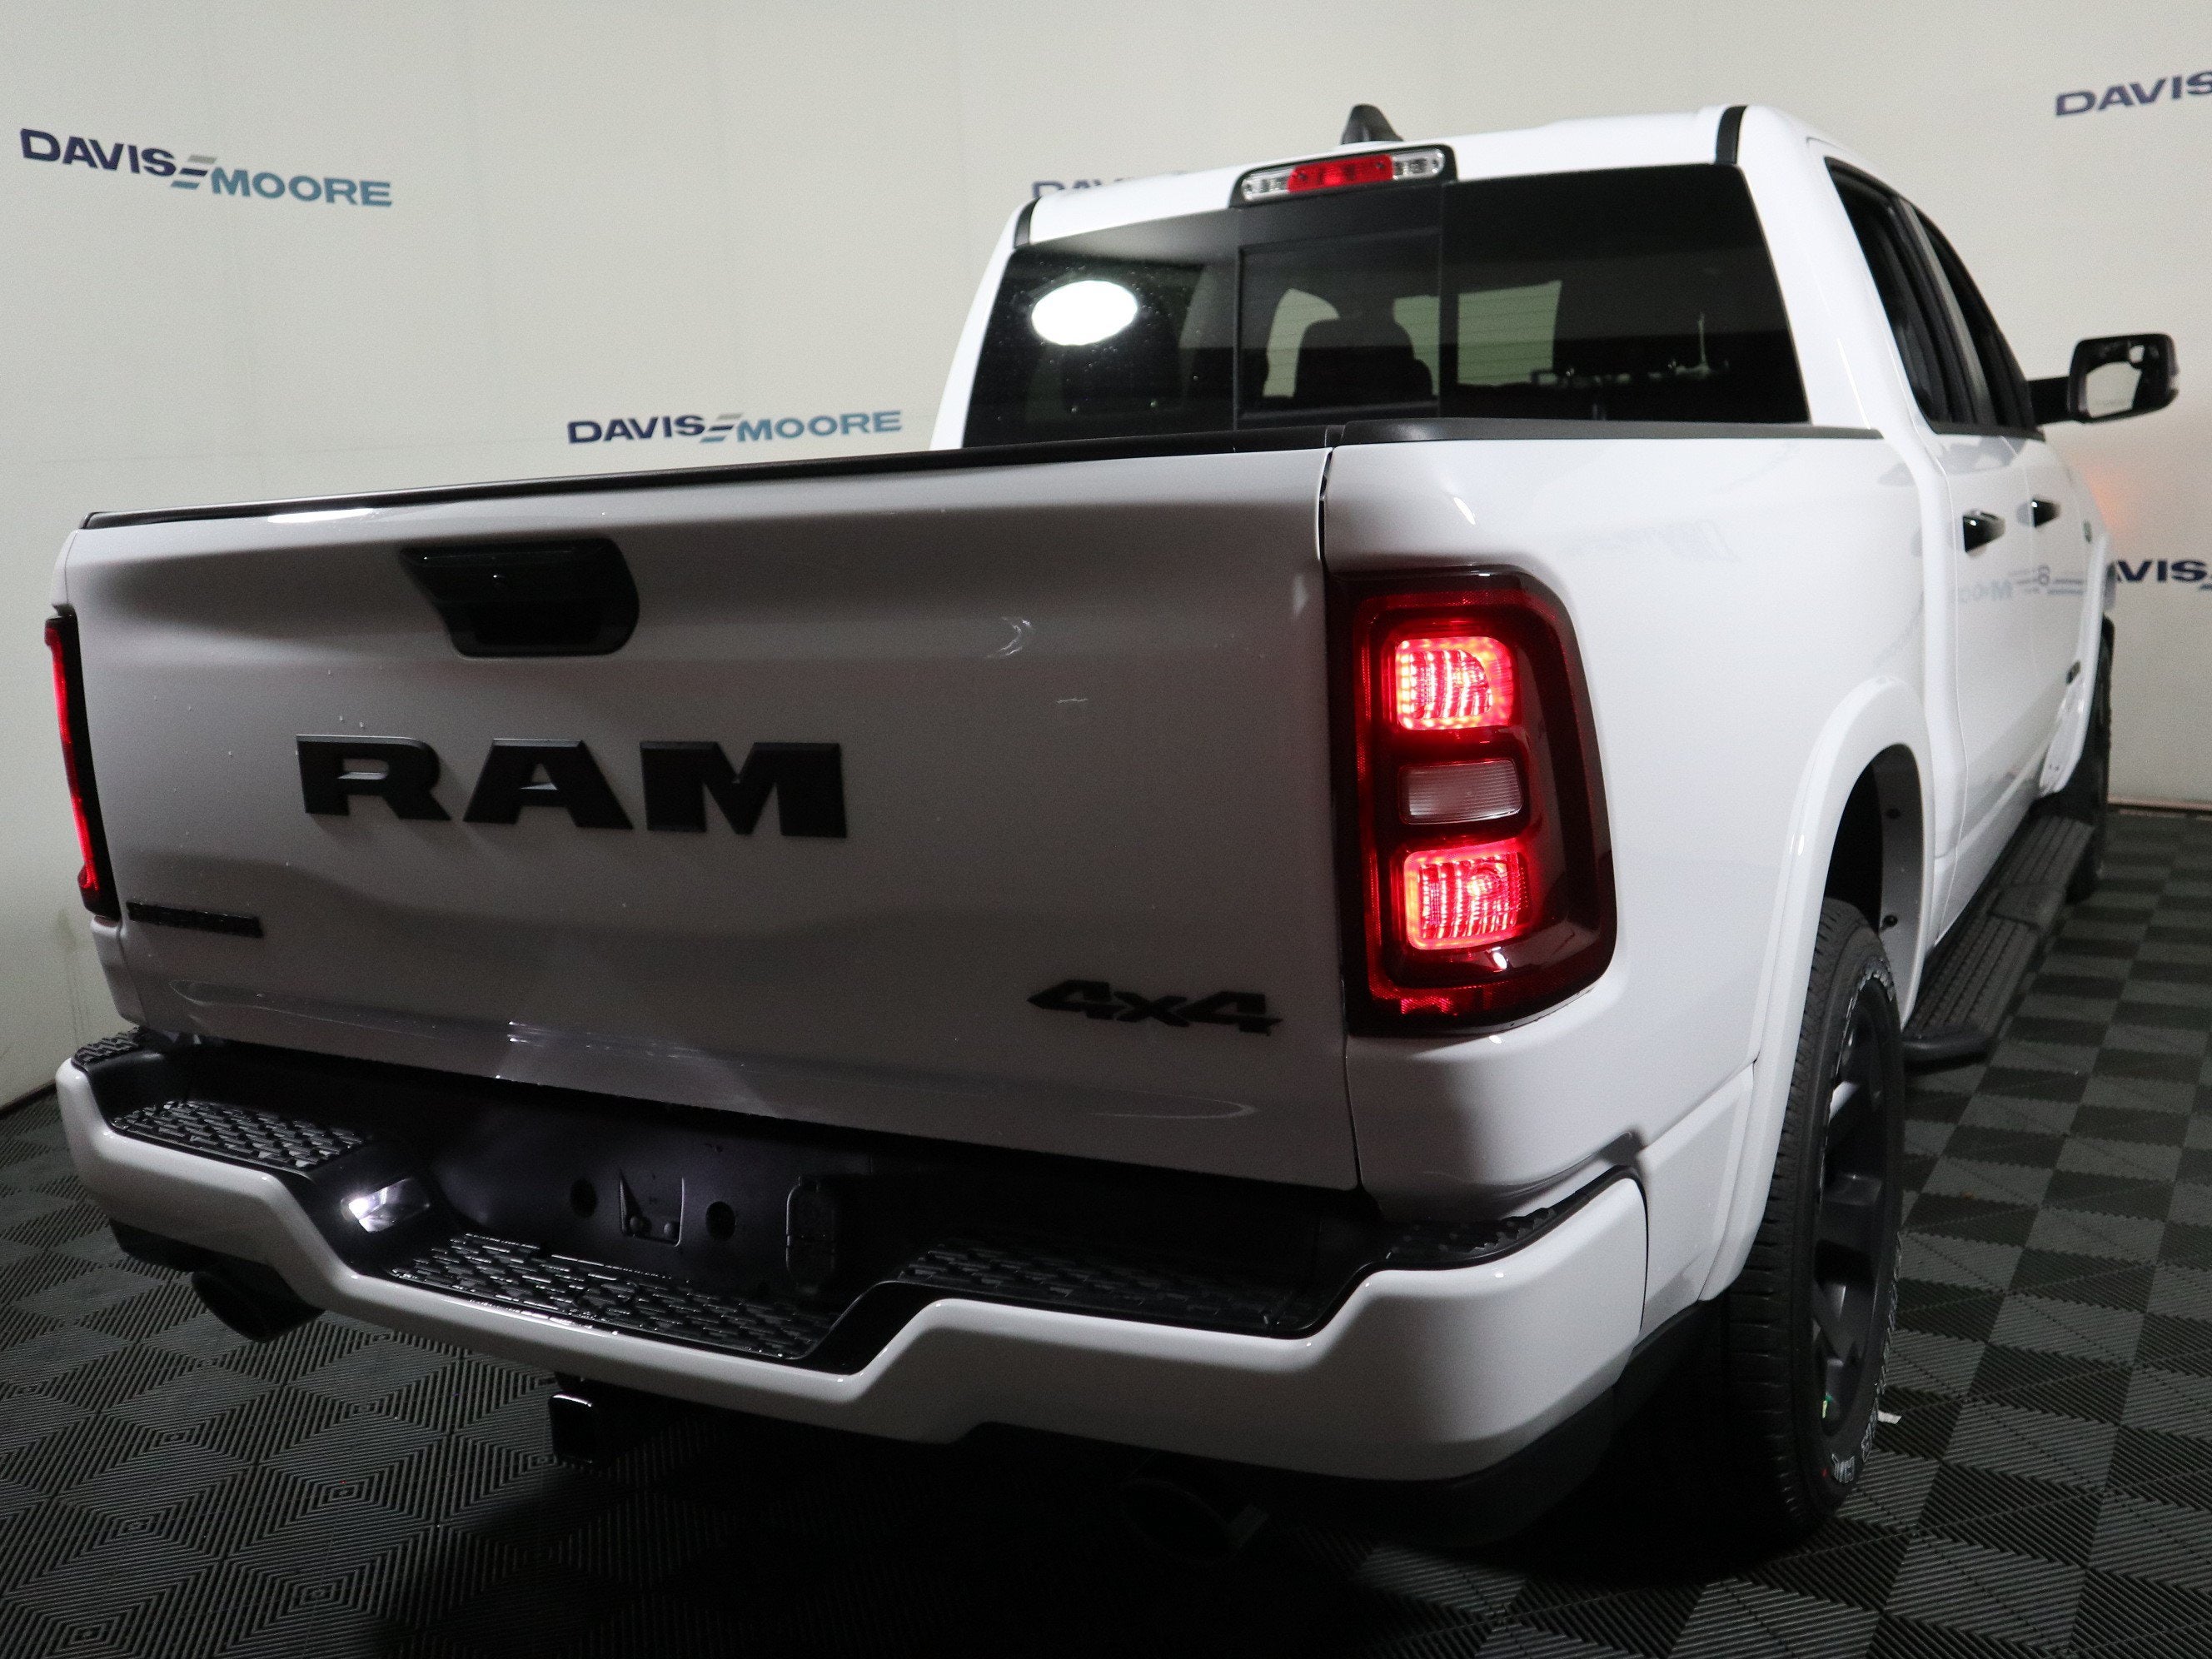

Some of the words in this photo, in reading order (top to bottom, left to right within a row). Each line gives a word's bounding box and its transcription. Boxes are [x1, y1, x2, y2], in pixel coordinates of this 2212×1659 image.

[2055, 70, 2212, 117] DAVIS
[20, 128, 177, 177] DAVIS
[210, 166, 392, 208] MOORE
[566, 415, 705, 445] DAVIS
[736, 410, 903, 443] MOORE
[2116, 559, 2208, 583] VIS
[296, 734, 848, 838] RAM
